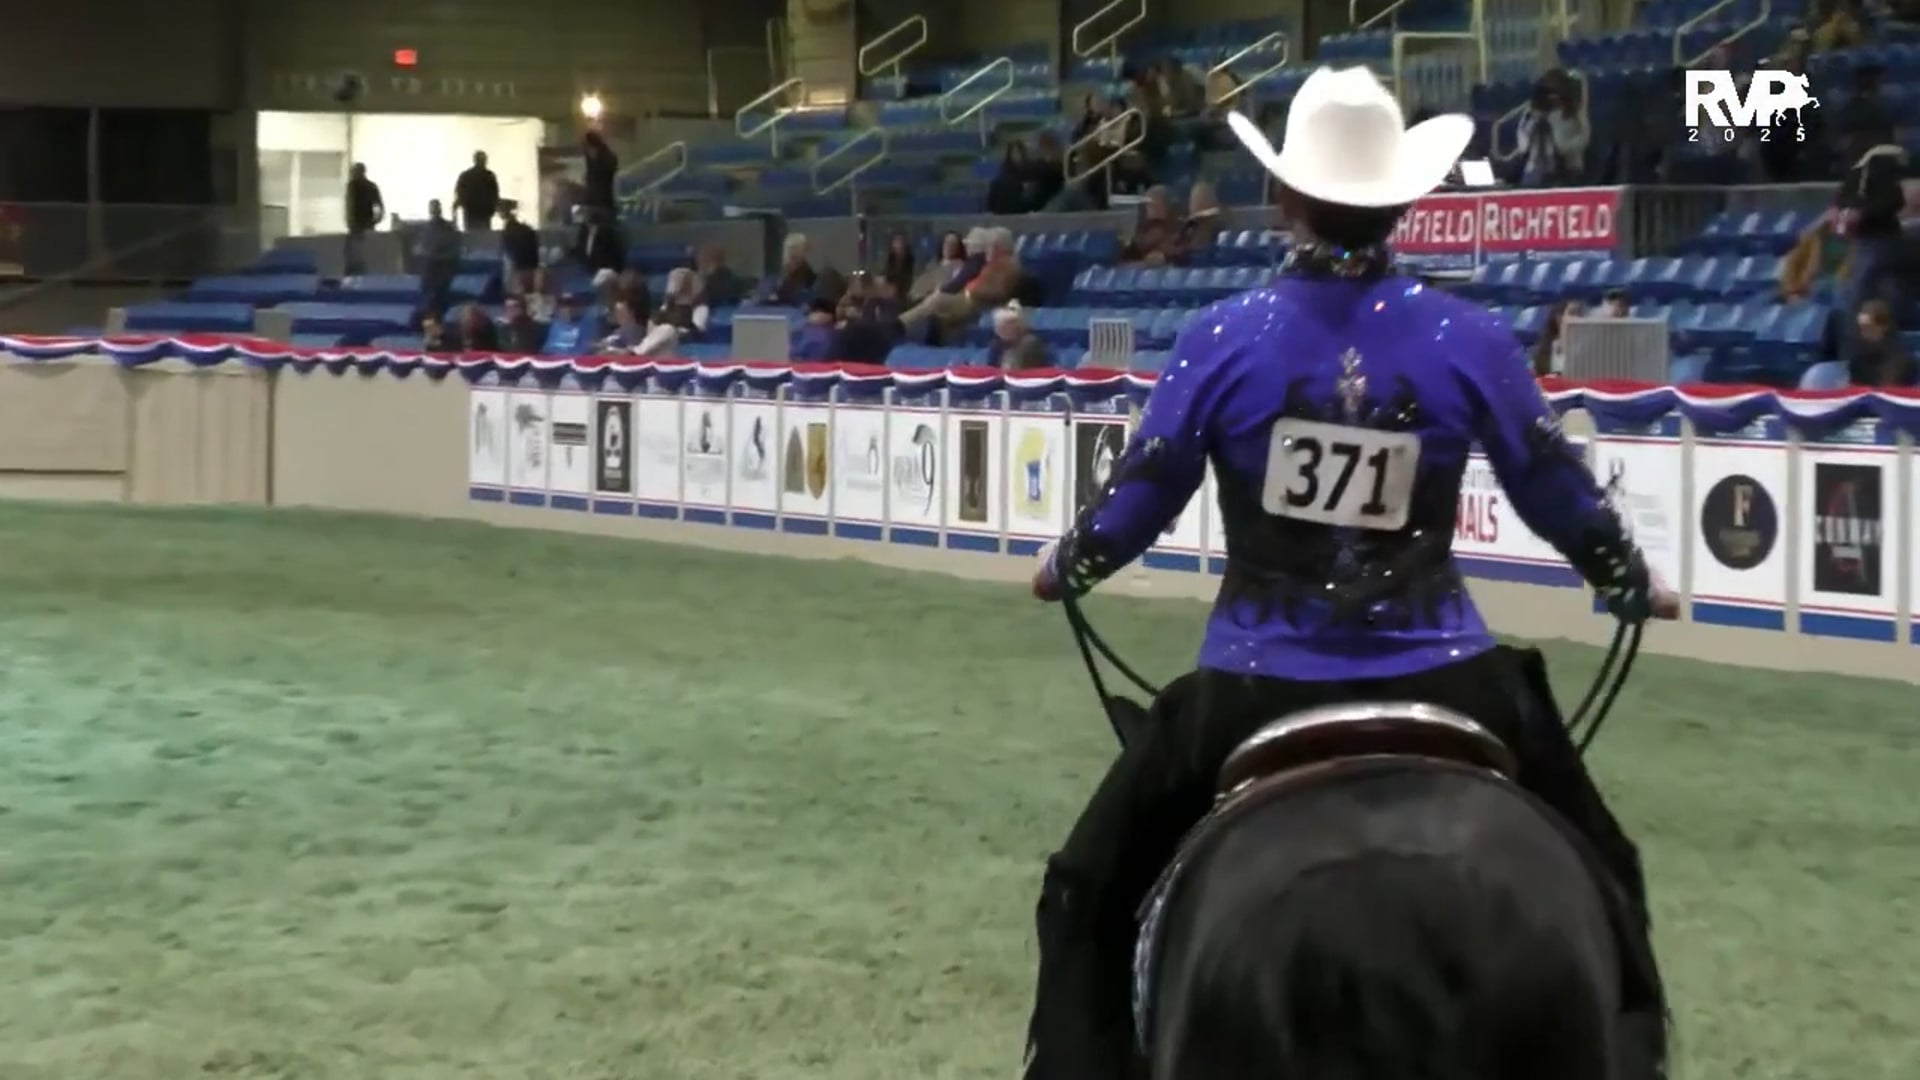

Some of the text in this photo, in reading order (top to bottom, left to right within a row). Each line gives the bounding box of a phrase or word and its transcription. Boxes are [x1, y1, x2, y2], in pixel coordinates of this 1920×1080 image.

[1391, 210, 1474, 244] HFIELD
[1483, 203, 1610, 241] RICHFIELD
[1285, 436, 1391, 516] 371
[1455, 493, 1499, 544] NALS
